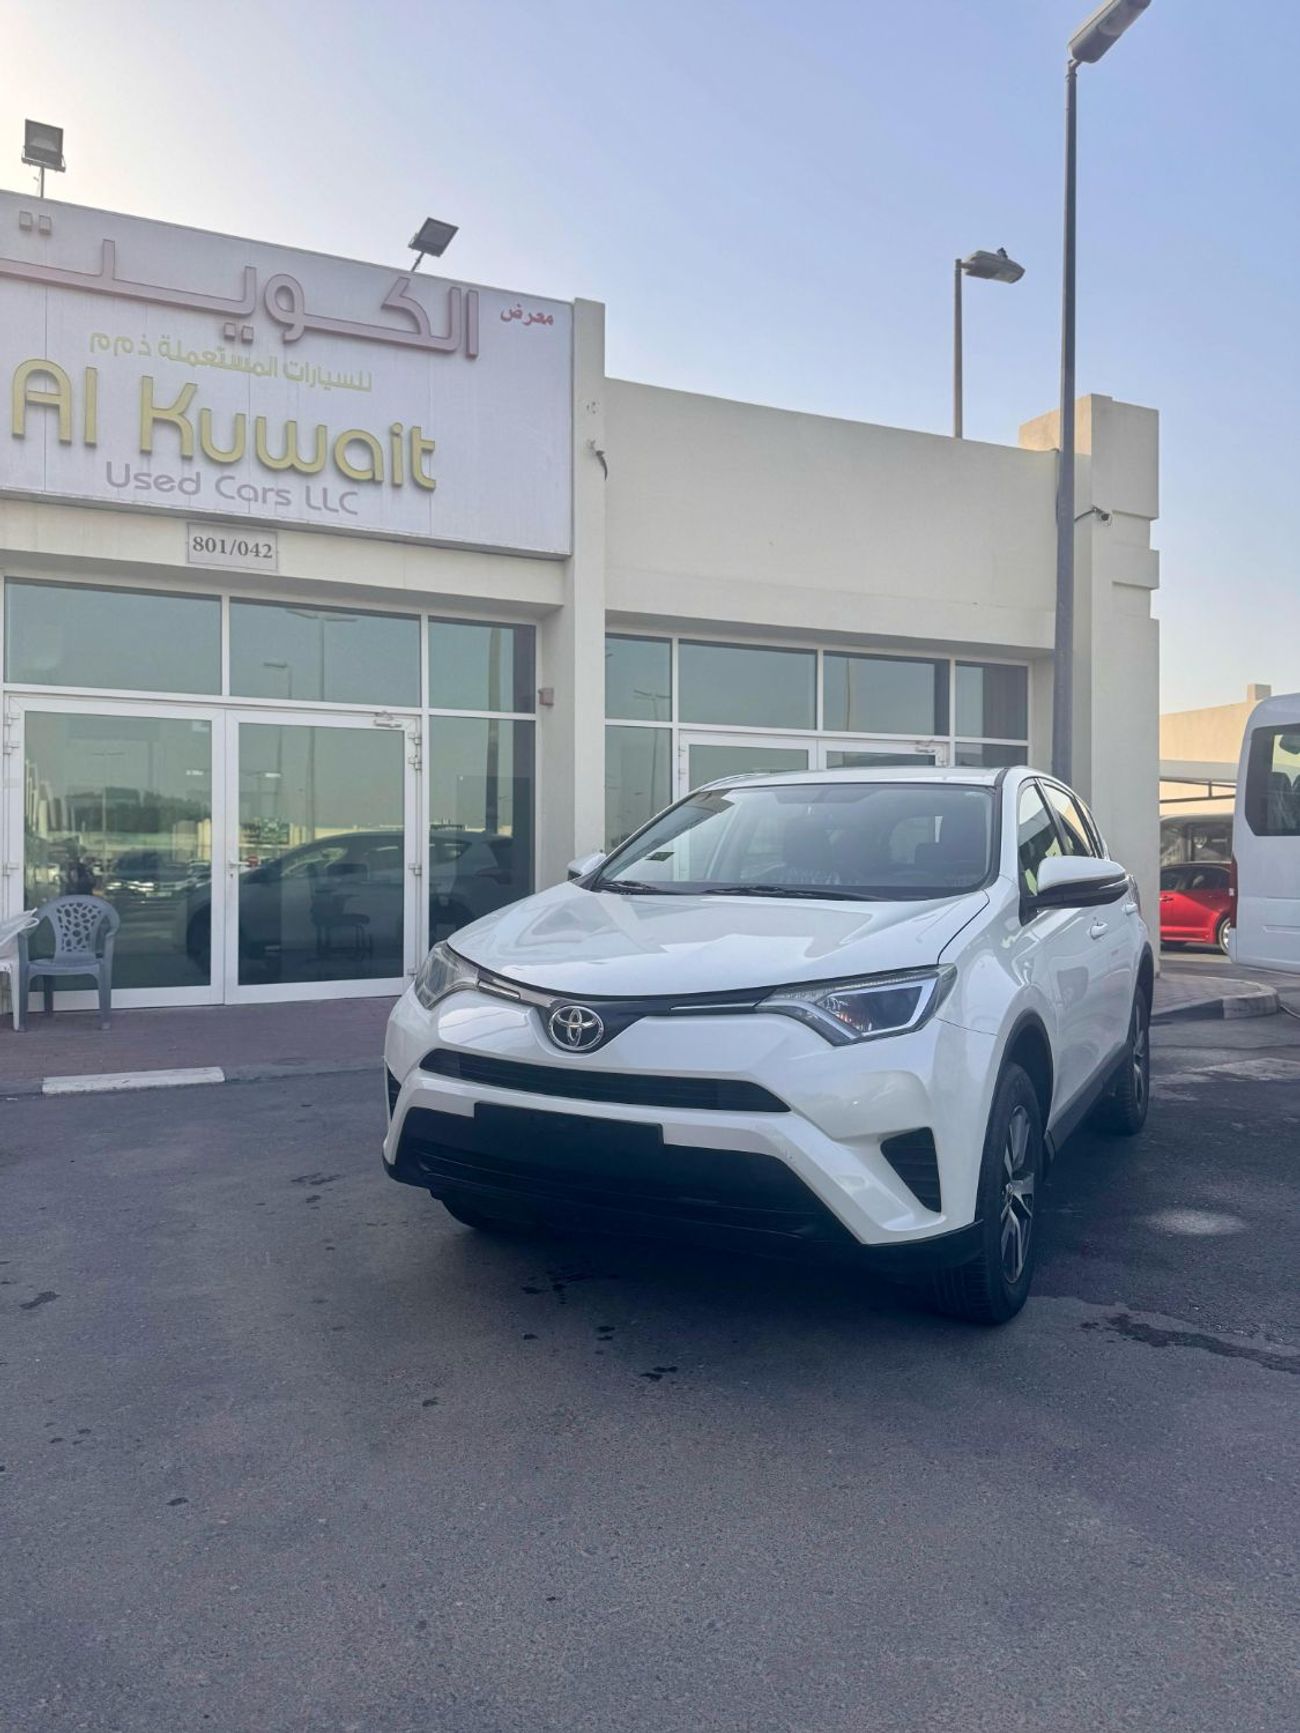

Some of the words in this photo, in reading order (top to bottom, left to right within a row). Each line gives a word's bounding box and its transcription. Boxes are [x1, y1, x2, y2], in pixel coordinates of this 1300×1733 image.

[500, 303, 554, 326] معرض
[158, 334, 278, 378] المستعملة
[284, 361, 372, 392] للسيارات
[12, 358, 98, 449] Al
[139, 375, 437, 491] Kuwait
[106, 461, 201, 496] Used
[215, 475, 292, 507] Cars
[305, 485, 359, 515] LLC
[192, 536, 273, 559] 801/042
